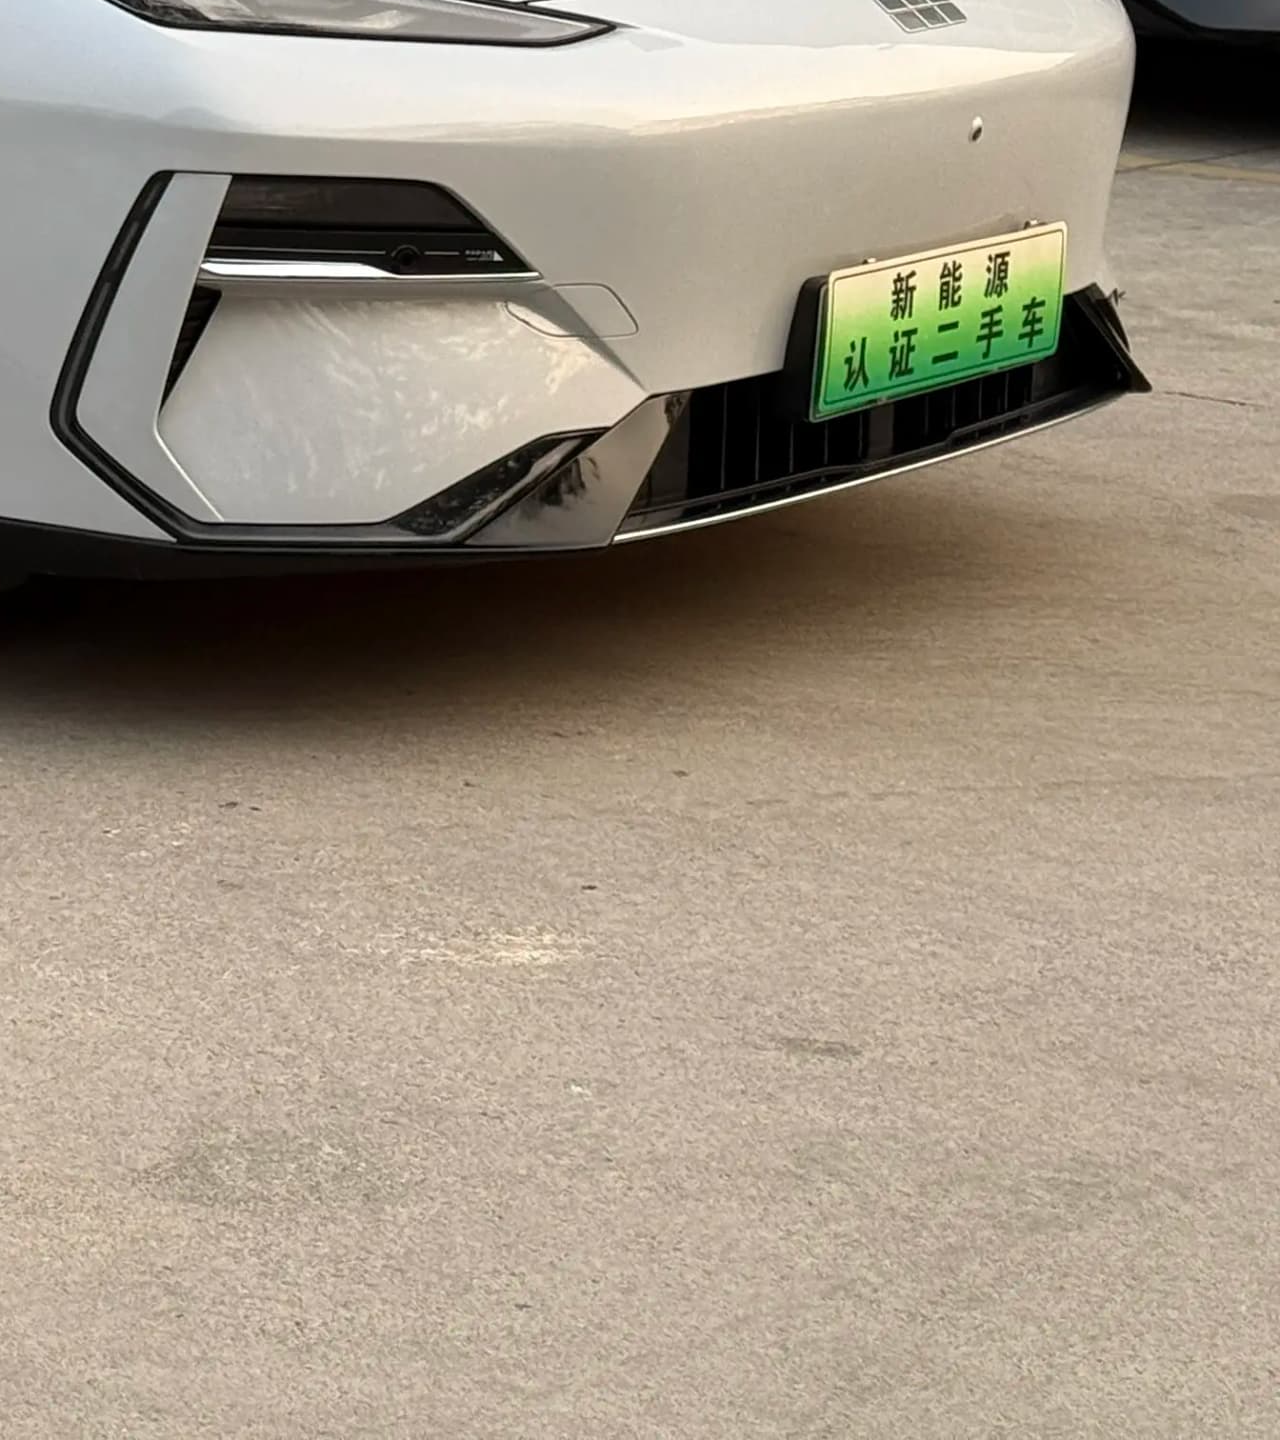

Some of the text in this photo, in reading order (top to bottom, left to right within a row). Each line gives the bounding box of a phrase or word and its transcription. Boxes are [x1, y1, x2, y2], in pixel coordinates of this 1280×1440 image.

[890, 250, 1011, 321] 新能源
[843, 297, 1047, 392] 认证二手车
